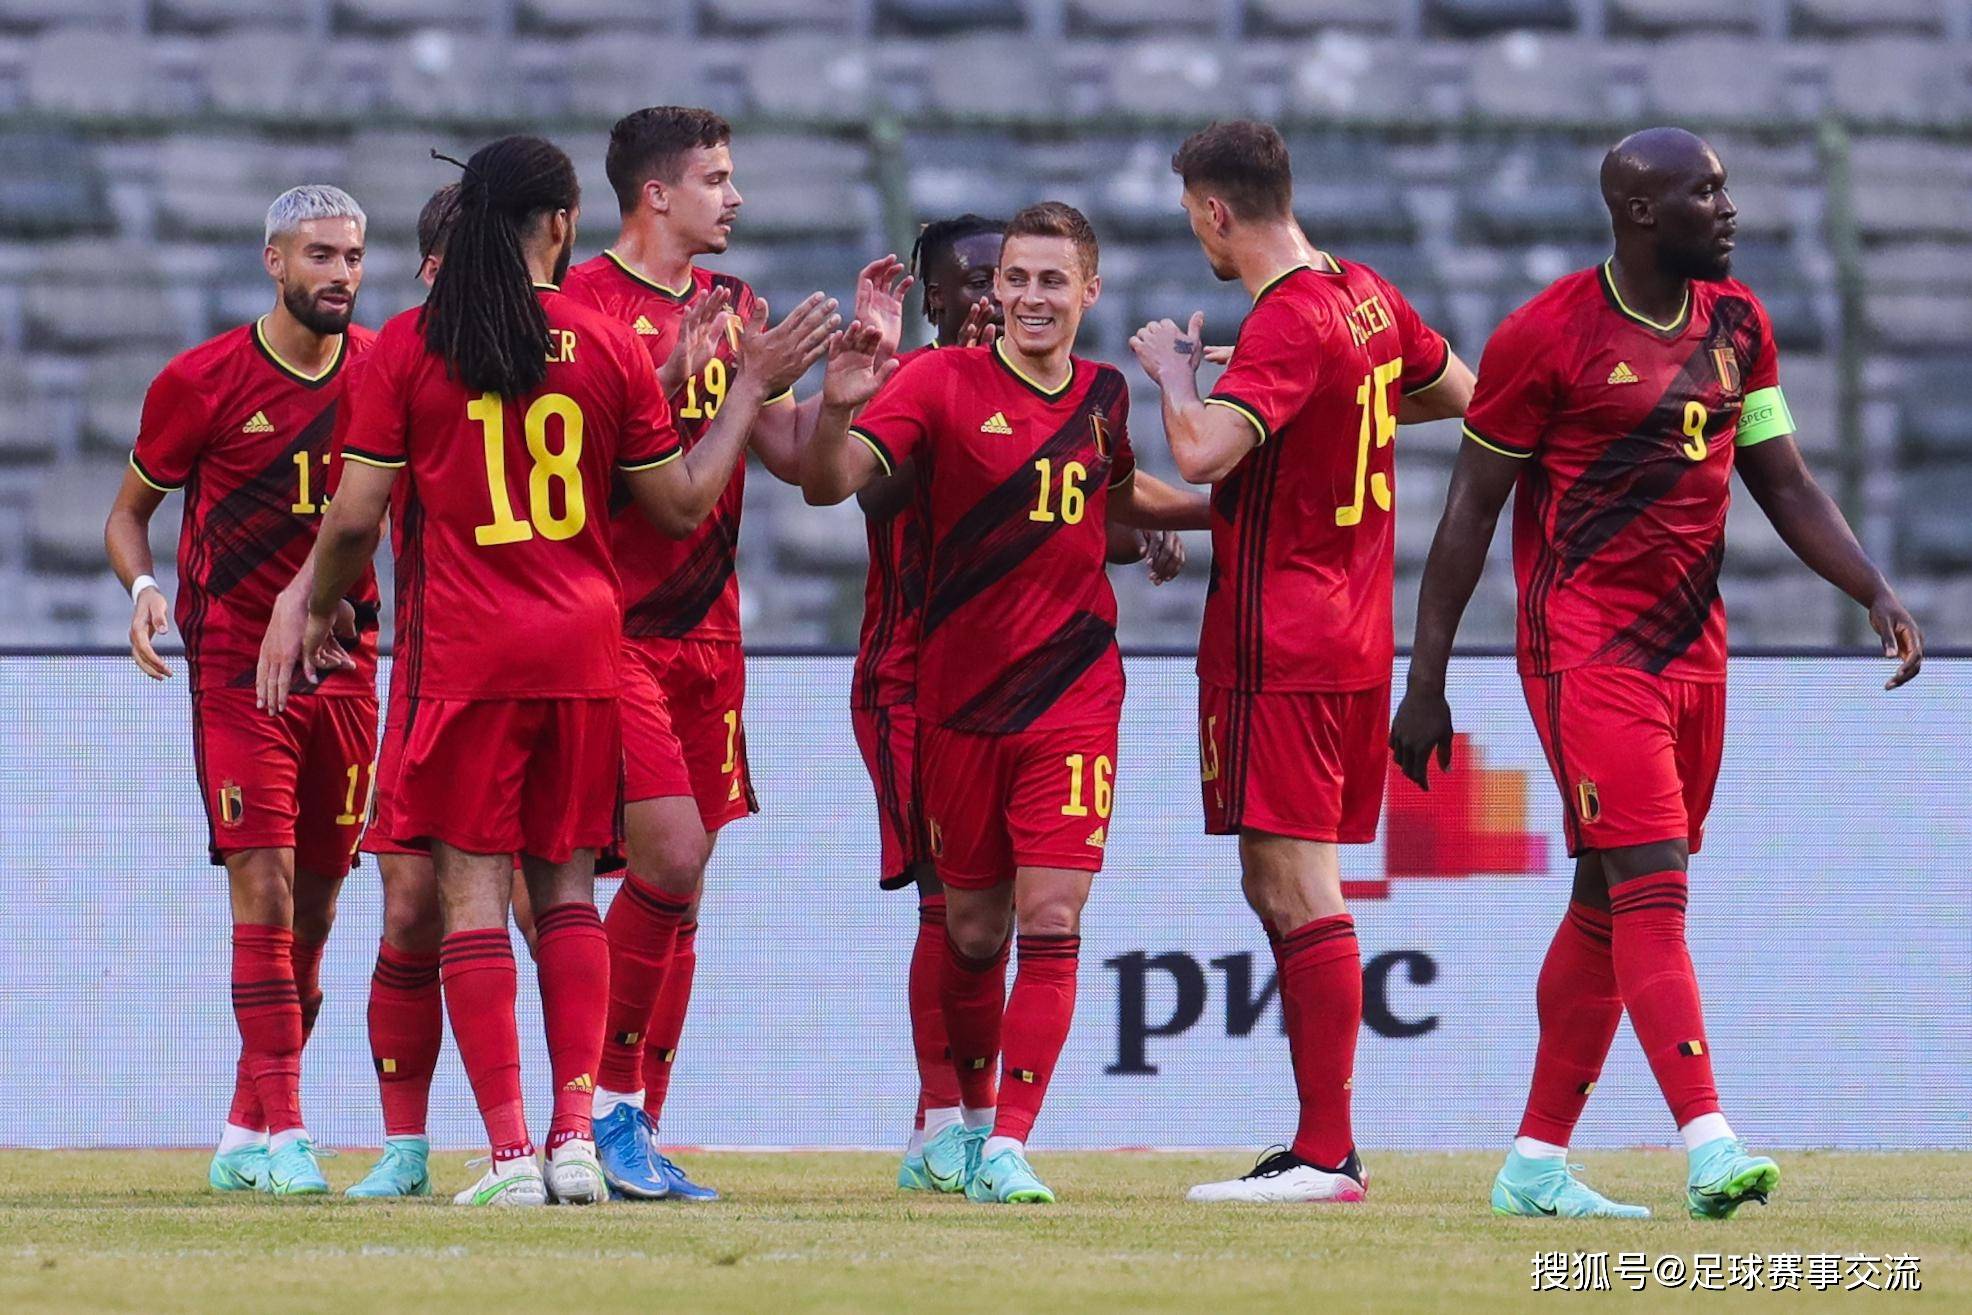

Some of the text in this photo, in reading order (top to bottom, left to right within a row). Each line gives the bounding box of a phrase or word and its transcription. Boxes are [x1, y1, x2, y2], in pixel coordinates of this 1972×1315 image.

[680, 357, 728, 421] 19
[1682, 400, 1708, 461] 9
[466, 391, 587, 547] 18
[1028, 457, 1088, 526] 16
[1061, 753, 1112, 819] 16
